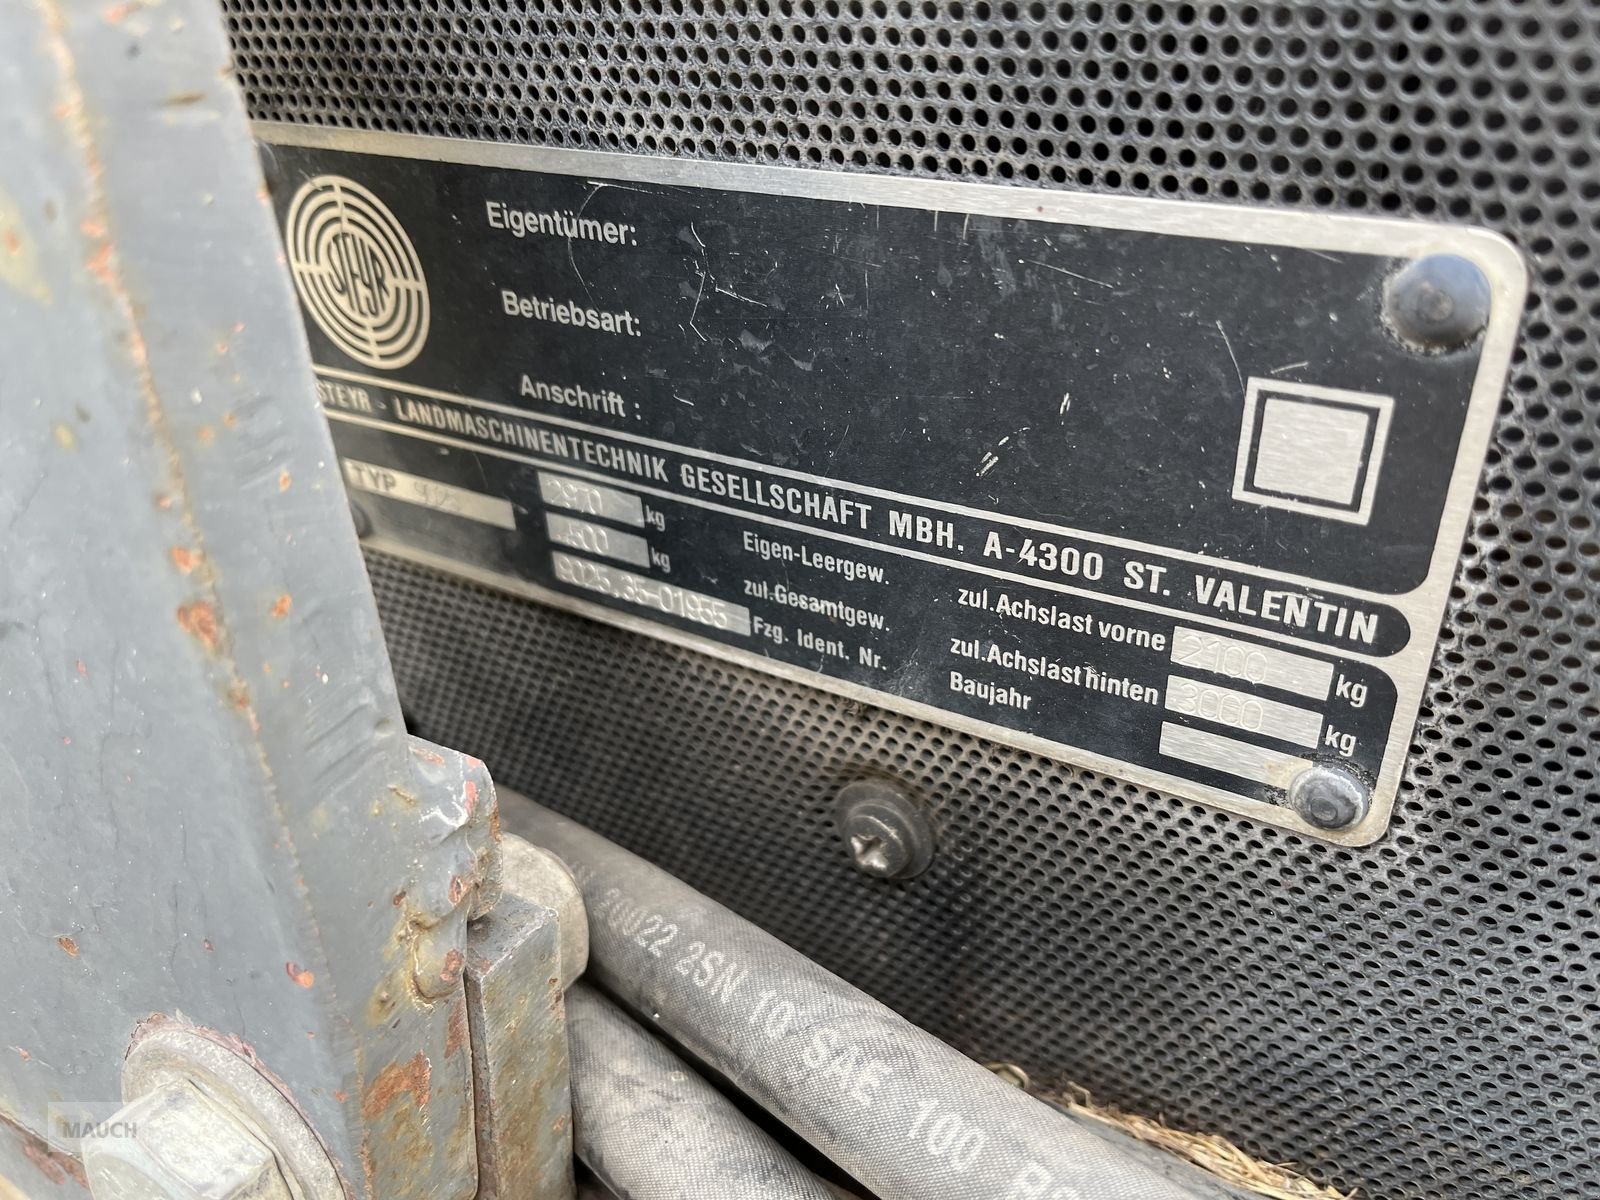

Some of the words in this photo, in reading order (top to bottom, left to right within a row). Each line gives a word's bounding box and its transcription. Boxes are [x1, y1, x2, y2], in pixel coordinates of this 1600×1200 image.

[485, 201, 638, 247] Eigentümer:
[327, 231, 390, 318] STEYR
[501, 289, 642, 337] Betriebsart:
[351, 465, 397, 491] TYP
[313, 379, 373, 413] STEYR
[393, 396, 669, 483] LANDMASCHINENTECHNIK
[679, 463, 872, 530] GESELLSCHAFT
[888, 509, 964, 552] MBH.
[982, 530, 1104, 582] A-4300
[1123, 560, 1171, 597] ST.
[1195, 574, 1379, 645] VALENTIN
[645, 504, 666, 533] kg
[651, 547, 671, 575] kg
[742, 529, 891, 585] Eigen-Leergew.
[742, 578, 892, 632] zul.Gesamtgew.
[957, 587, 1093, 636] zul.Achslast
[1098, 620, 1167, 652] vorne
[753, 615, 790, 643] Fzg.
[797, 629, 850, 660] Ident.
[858, 646, 888, 671] Nr.
[1178, 633, 1269, 685] 2100
[1334, 674, 1369, 709] kg
[950, 637, 1082, 686] zul.Achslast
[1084, 666, 1160, 706] hinten
[950, 671, 1032, 711] Baujahr
[1172, 682, 1265, 732] 3000
[1324, 724, 1357, 758] kg
[674, 940, 750, 1005] 2SN
[907, 1098, 986, 1172] 100
